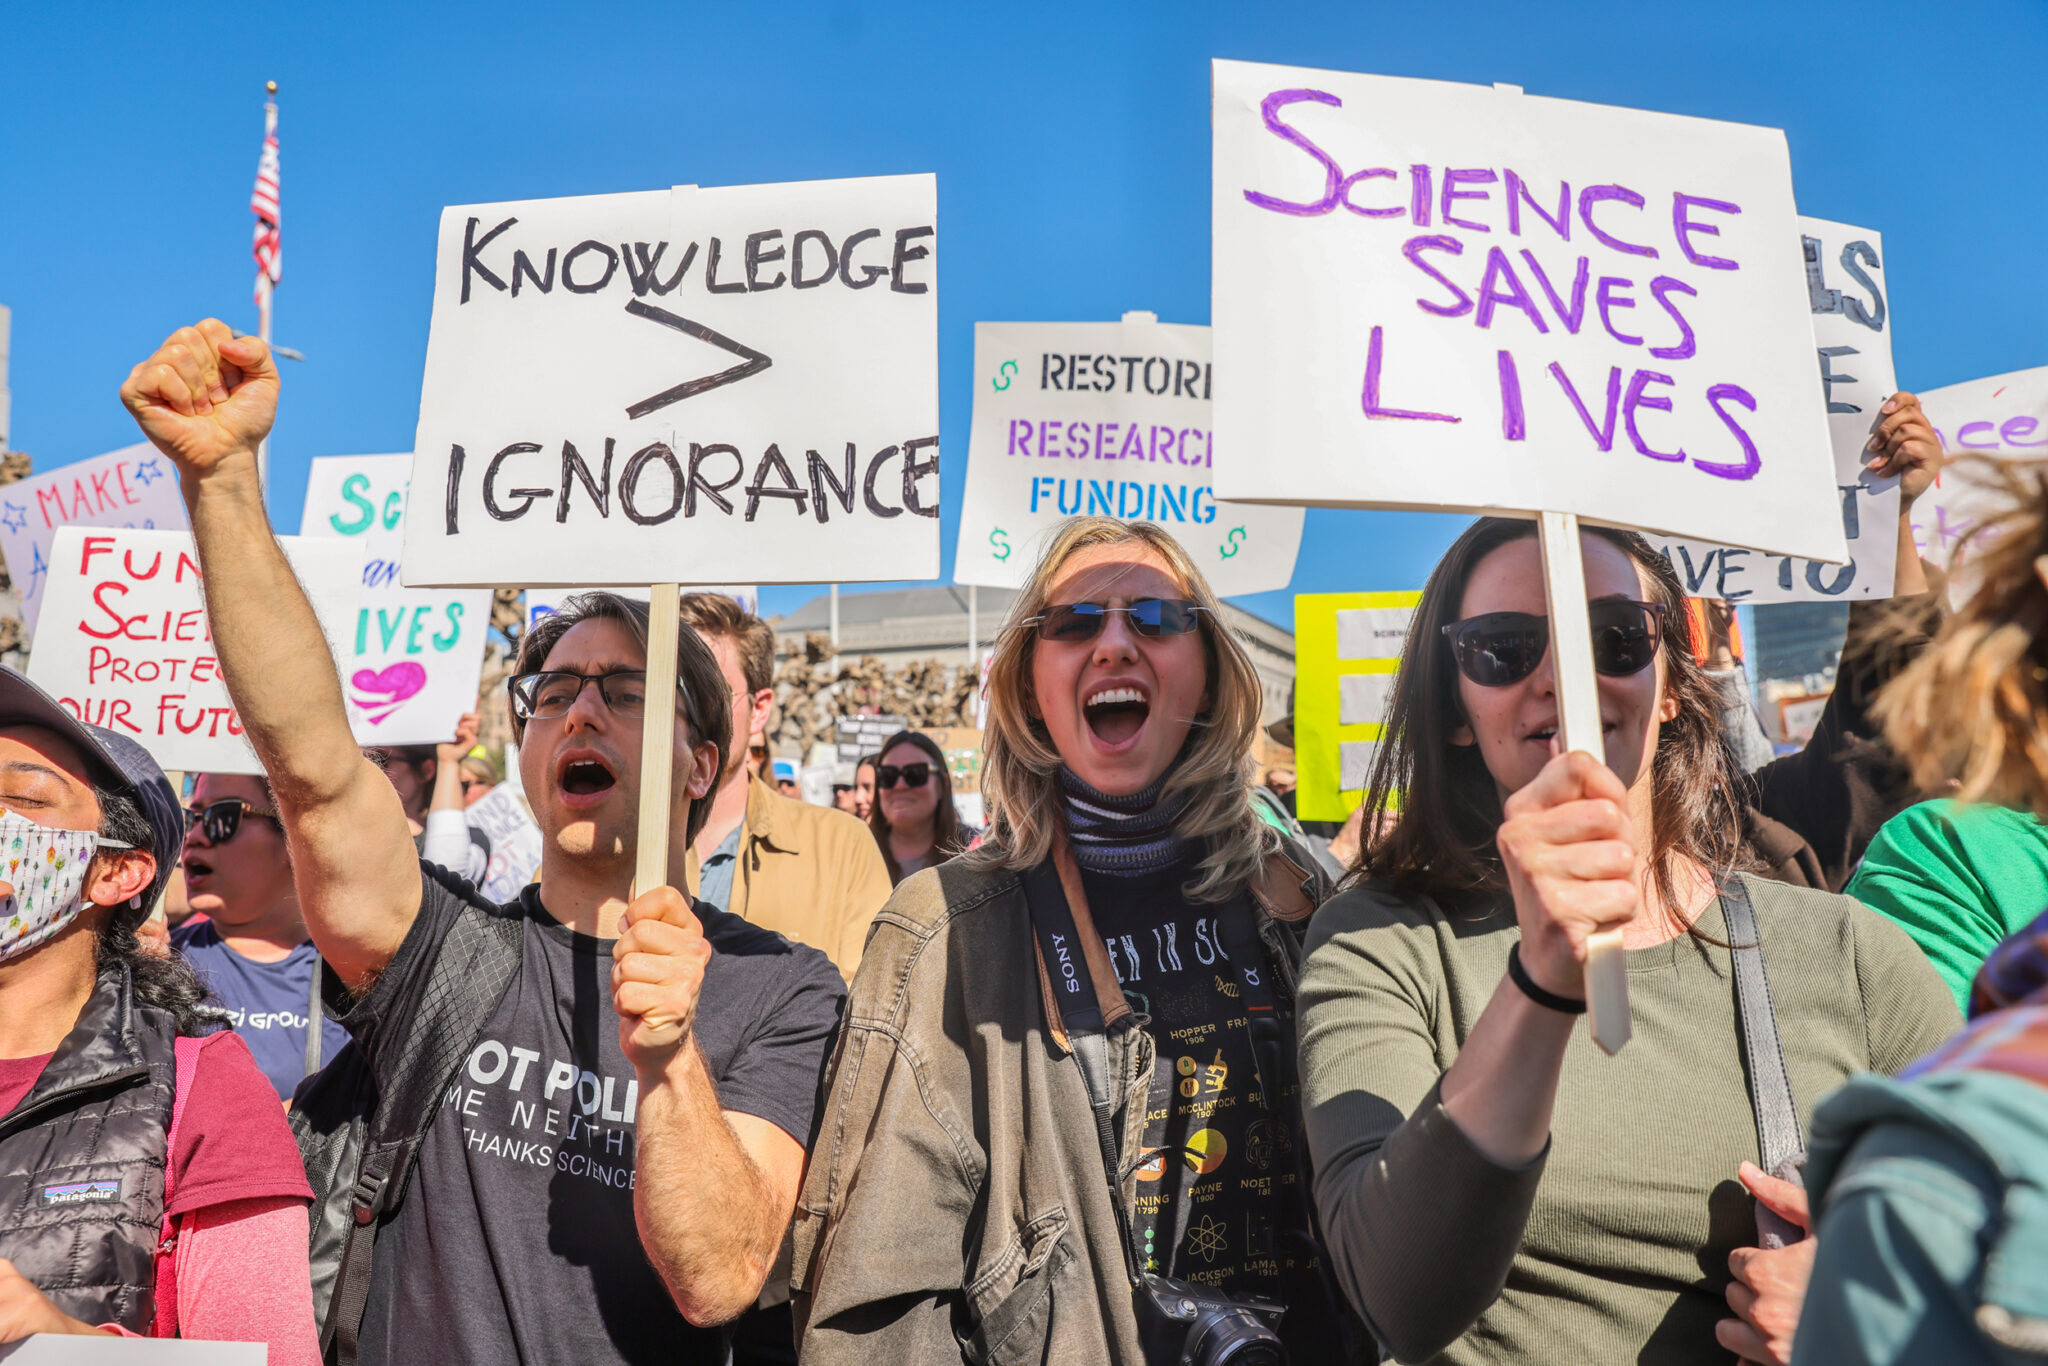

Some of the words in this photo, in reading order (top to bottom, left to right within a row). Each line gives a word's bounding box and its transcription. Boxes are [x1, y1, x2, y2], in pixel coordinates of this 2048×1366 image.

[1243, 88, 1742, 271] SCIENCE
[460, 216, 935, 305] KNOWLEDGE
[1402, 234, 1698, 360] SAVES
[1040, 353, 1212, 400] RESTOR
[1361, 325, 1762, 481] LIVES
[36, 461, 142, 530] MAKE
[445, 435, 940, 536] IGNORANCE
[1030, 476, 1217, 524] FUNDING
[78, 581, 211, 642] SCIE
[1051, 932, 1081, 993] SONY
[1151, 921, 1183, 973] IN
[1169, 1022, 1217, 1041] HOPPER
[1184, 1034, 1206, 1047] 1906
[458, 1039, 540, 1092] OT
[1178, 1096, 1237, 1116] MCCLINTOCK
[1195, 1109, 1216, 1120] 1902
[49, 1188, 113, 1205] patagonia
[1136, 1206, 1160, 1215] 1799
[1195, 1193, 1216, 1204] 1900
[1187, 1182, 1224, 1198] PAYNE
[1186, 1266, 1235, 1283] JACKSON
[1197, 1301, 1222, 1310] SONY
